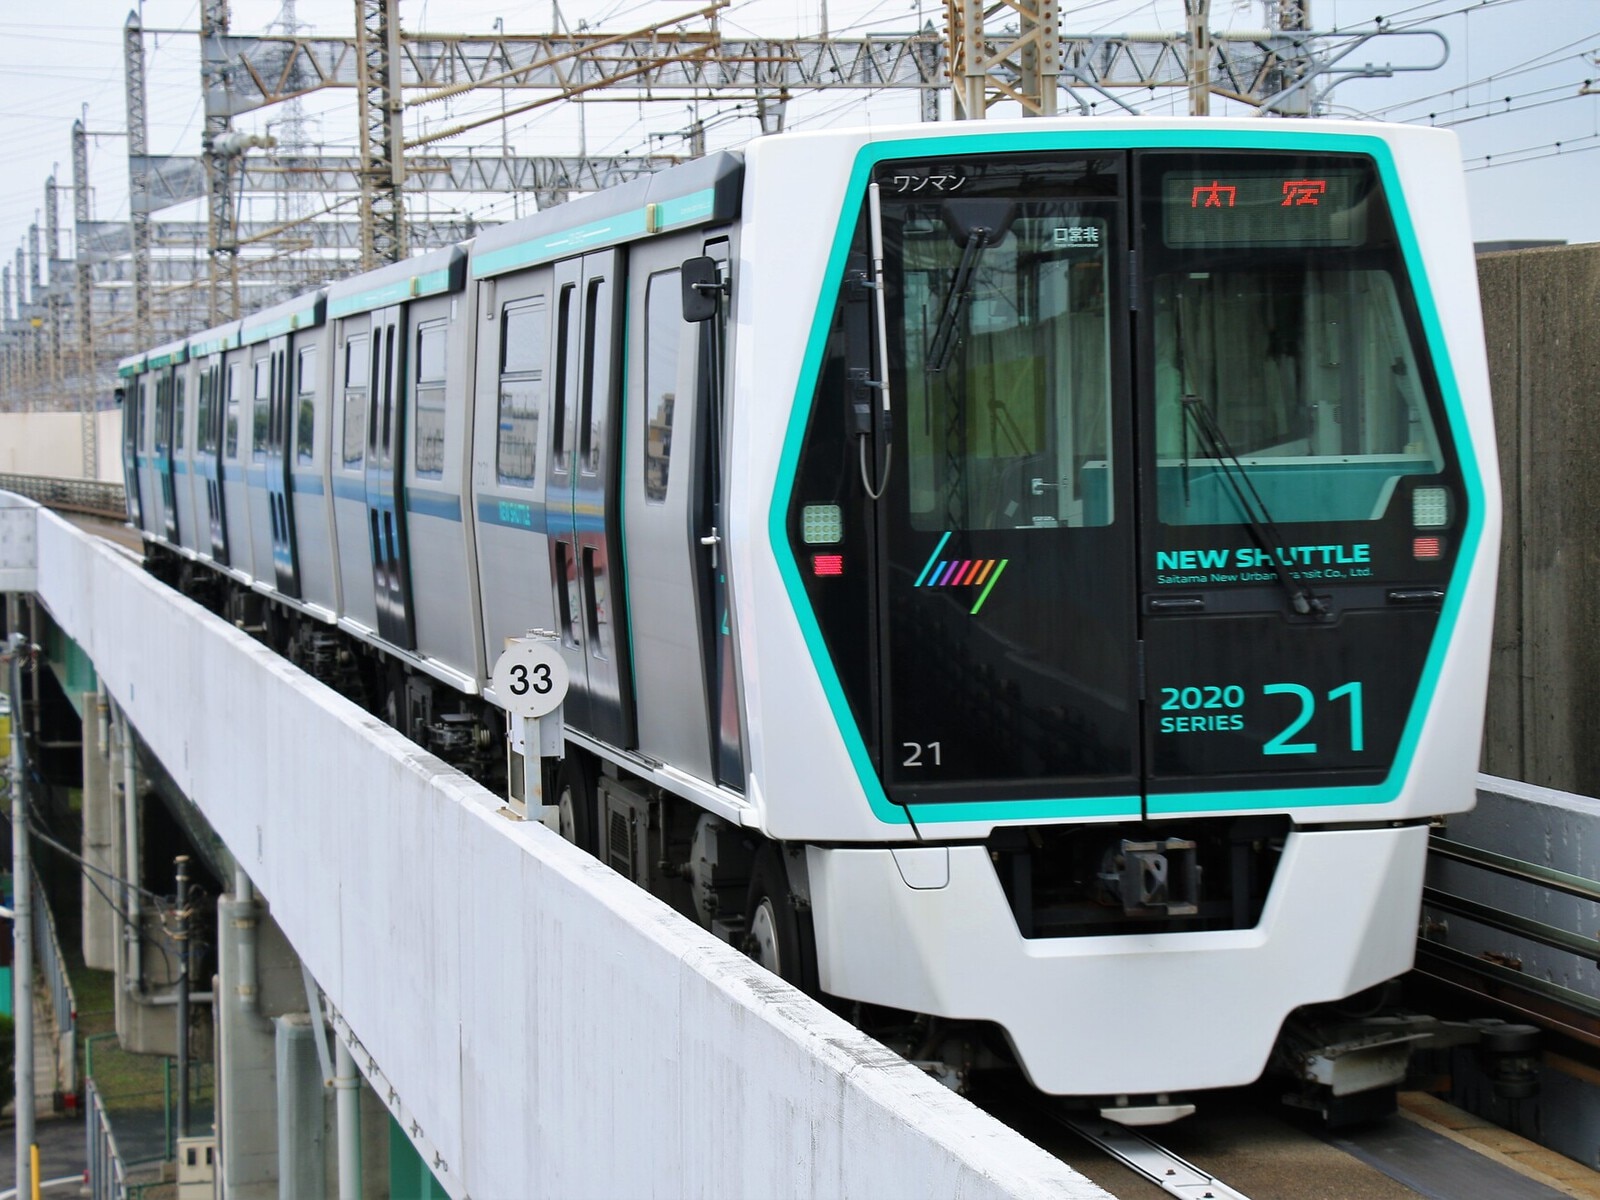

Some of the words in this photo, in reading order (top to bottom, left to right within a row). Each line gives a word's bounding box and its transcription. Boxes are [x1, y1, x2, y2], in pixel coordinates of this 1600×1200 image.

[893, 174, 966, 193] ワンマン
[1156, 549, 1230, 570] NEW
[1157, 574, 1208, 584] Saitama
[1210, 573, 1238, 582] New
[1240, 571, 1279, 581] Urban
[509, 663, 553, 696] 33
[1160, 684, 1246, 711] 2020
[1160, 714, 1245, 735] SERIES
[1262, 680, 1365, 756] 21
[902, 740, 942, 769] 21
